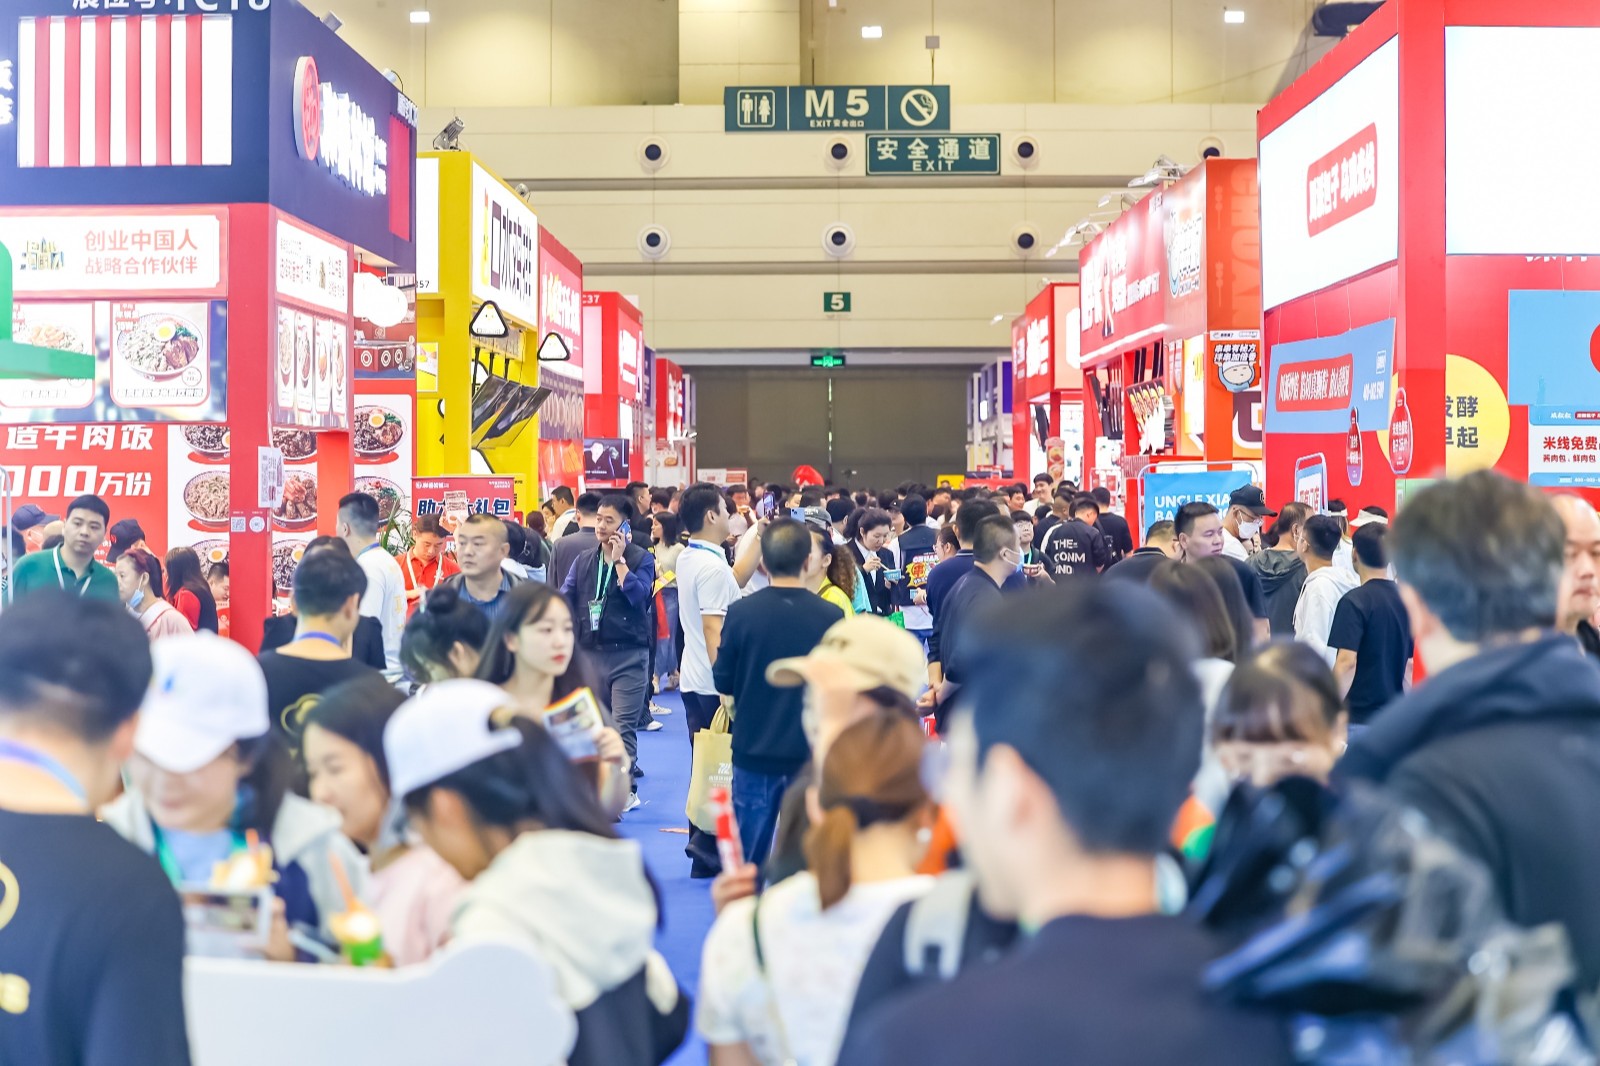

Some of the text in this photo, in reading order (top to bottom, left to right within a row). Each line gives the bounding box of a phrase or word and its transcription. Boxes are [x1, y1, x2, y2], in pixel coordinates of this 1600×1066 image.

[805, 89, 869, 118] M 5
[833, 119, 865, 127] 安全出口
[877, 138, 991, 160] 安全通道
[912, 160, 955, 171] EXIT
[85, 229, 198, 252] 创业中国人
[85, 256, 198, 275] 战略合作伙伴
[831, 294, 845, 310] 5
[1543, 435, 1600, 451] 米线免费
